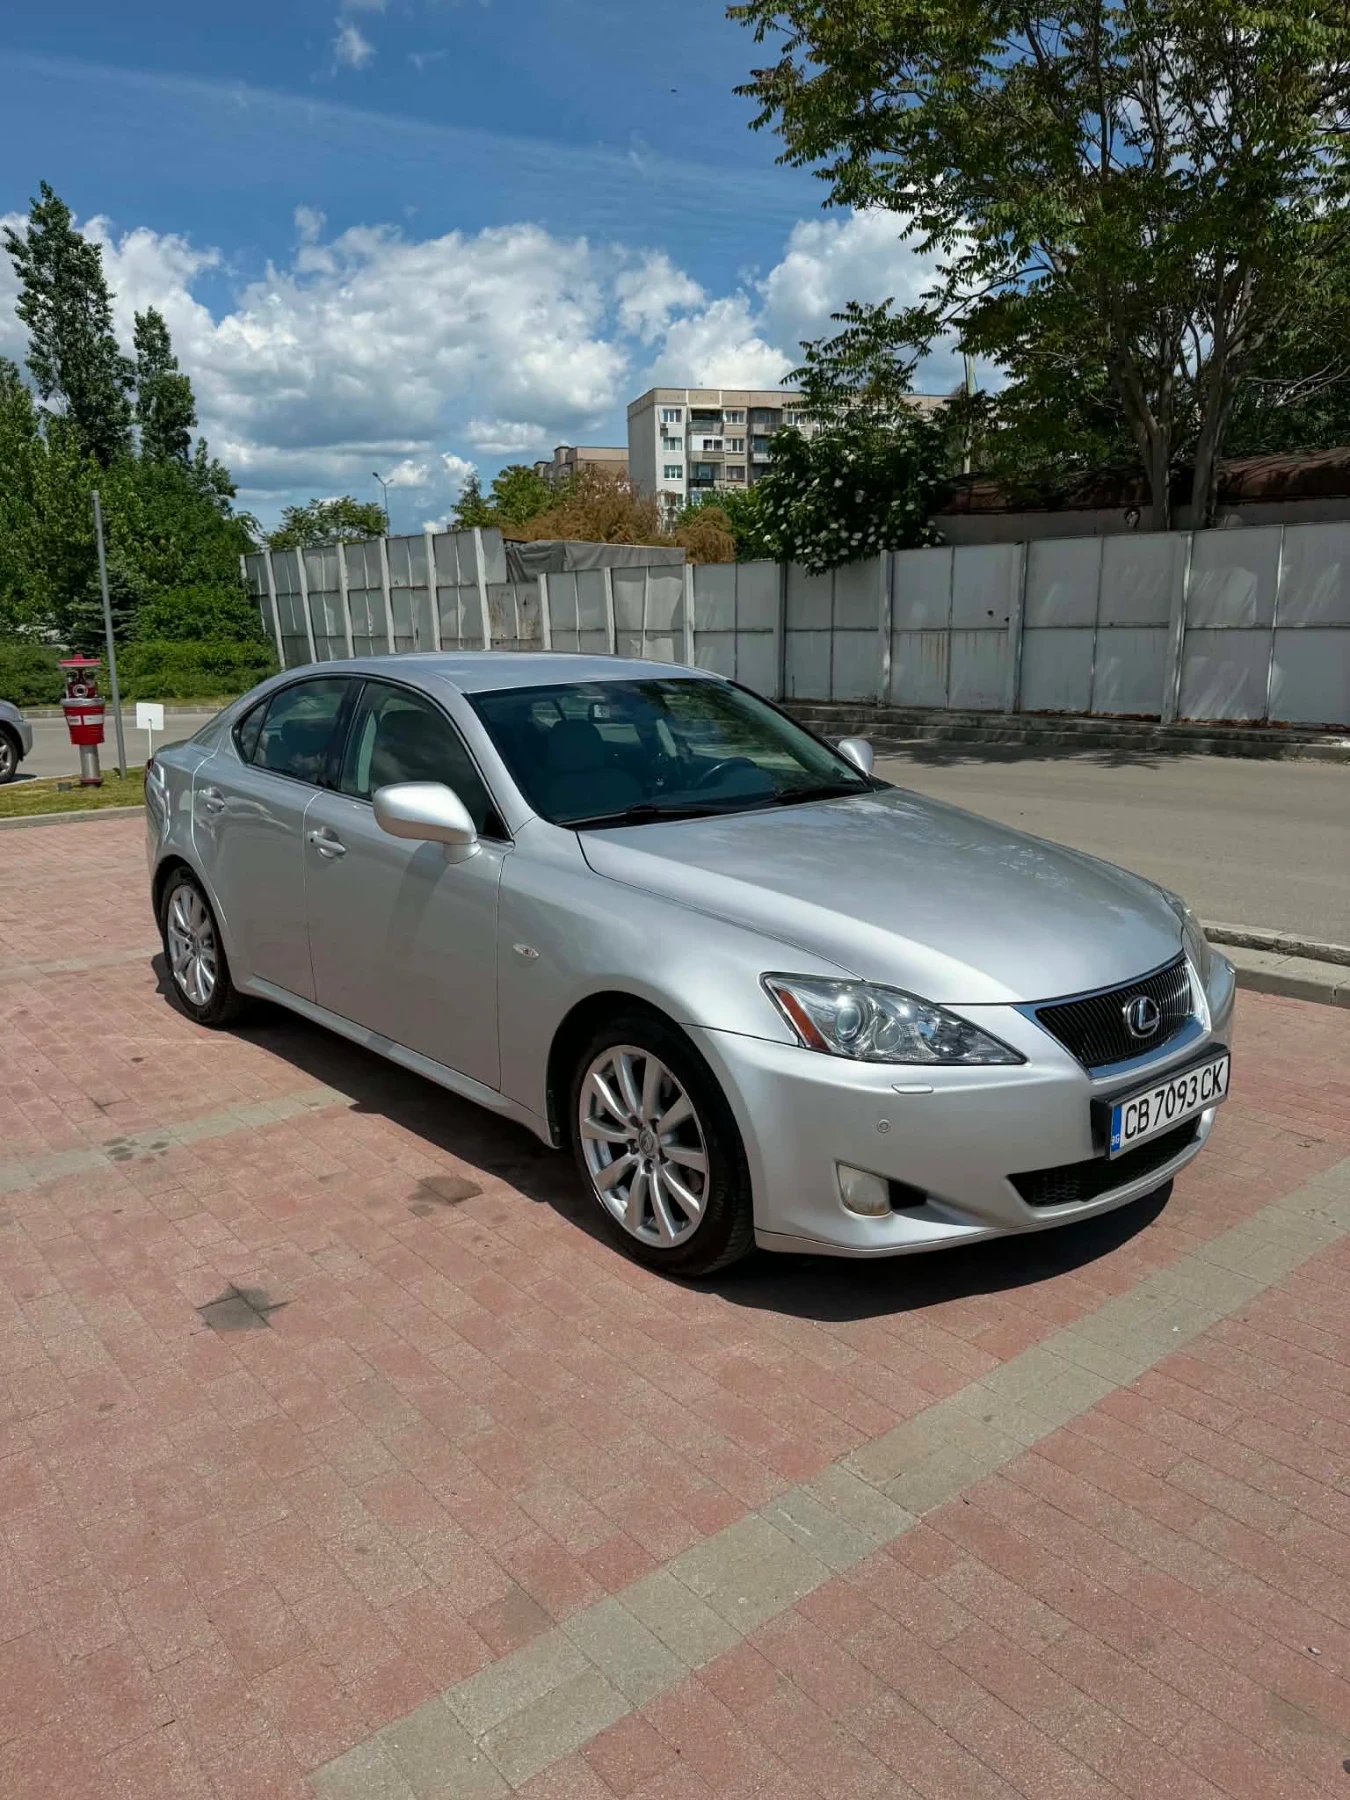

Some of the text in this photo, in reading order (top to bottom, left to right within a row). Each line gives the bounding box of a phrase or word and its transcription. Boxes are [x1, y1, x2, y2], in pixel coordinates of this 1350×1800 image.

[1125, 1062, 1223, 1139] CB 7093 CK
